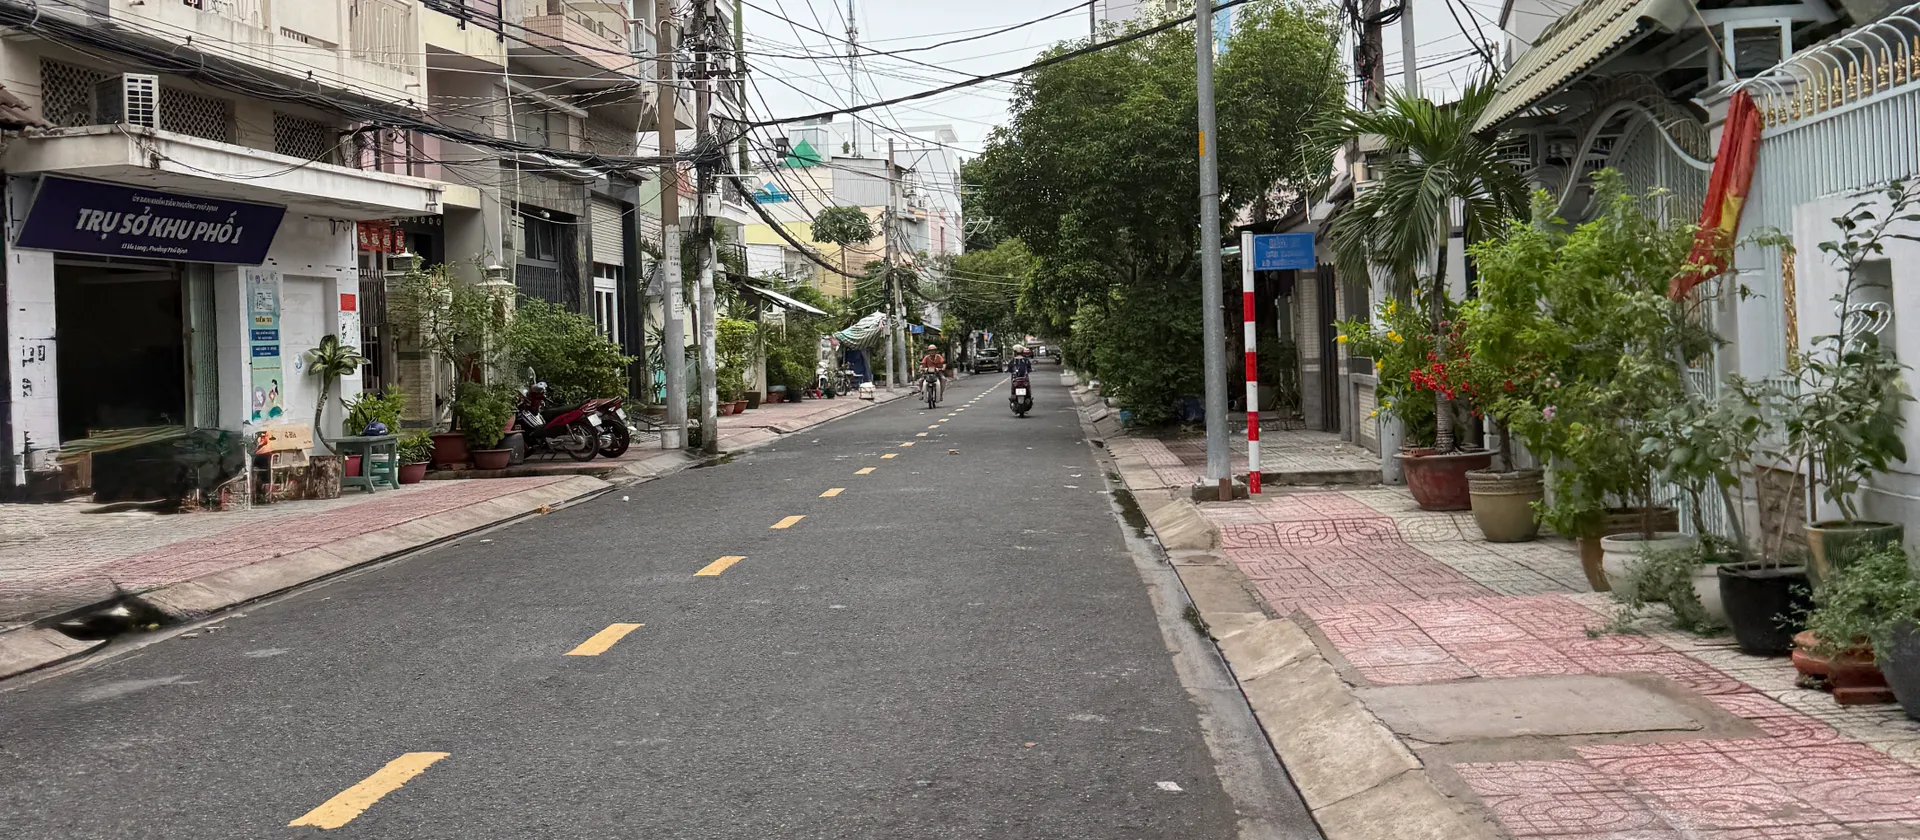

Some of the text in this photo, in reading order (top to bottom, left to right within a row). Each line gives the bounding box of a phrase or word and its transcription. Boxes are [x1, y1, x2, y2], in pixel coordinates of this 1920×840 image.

[75, 206, 243, 244] TRỤ SỞ KHU PHỐ 1
